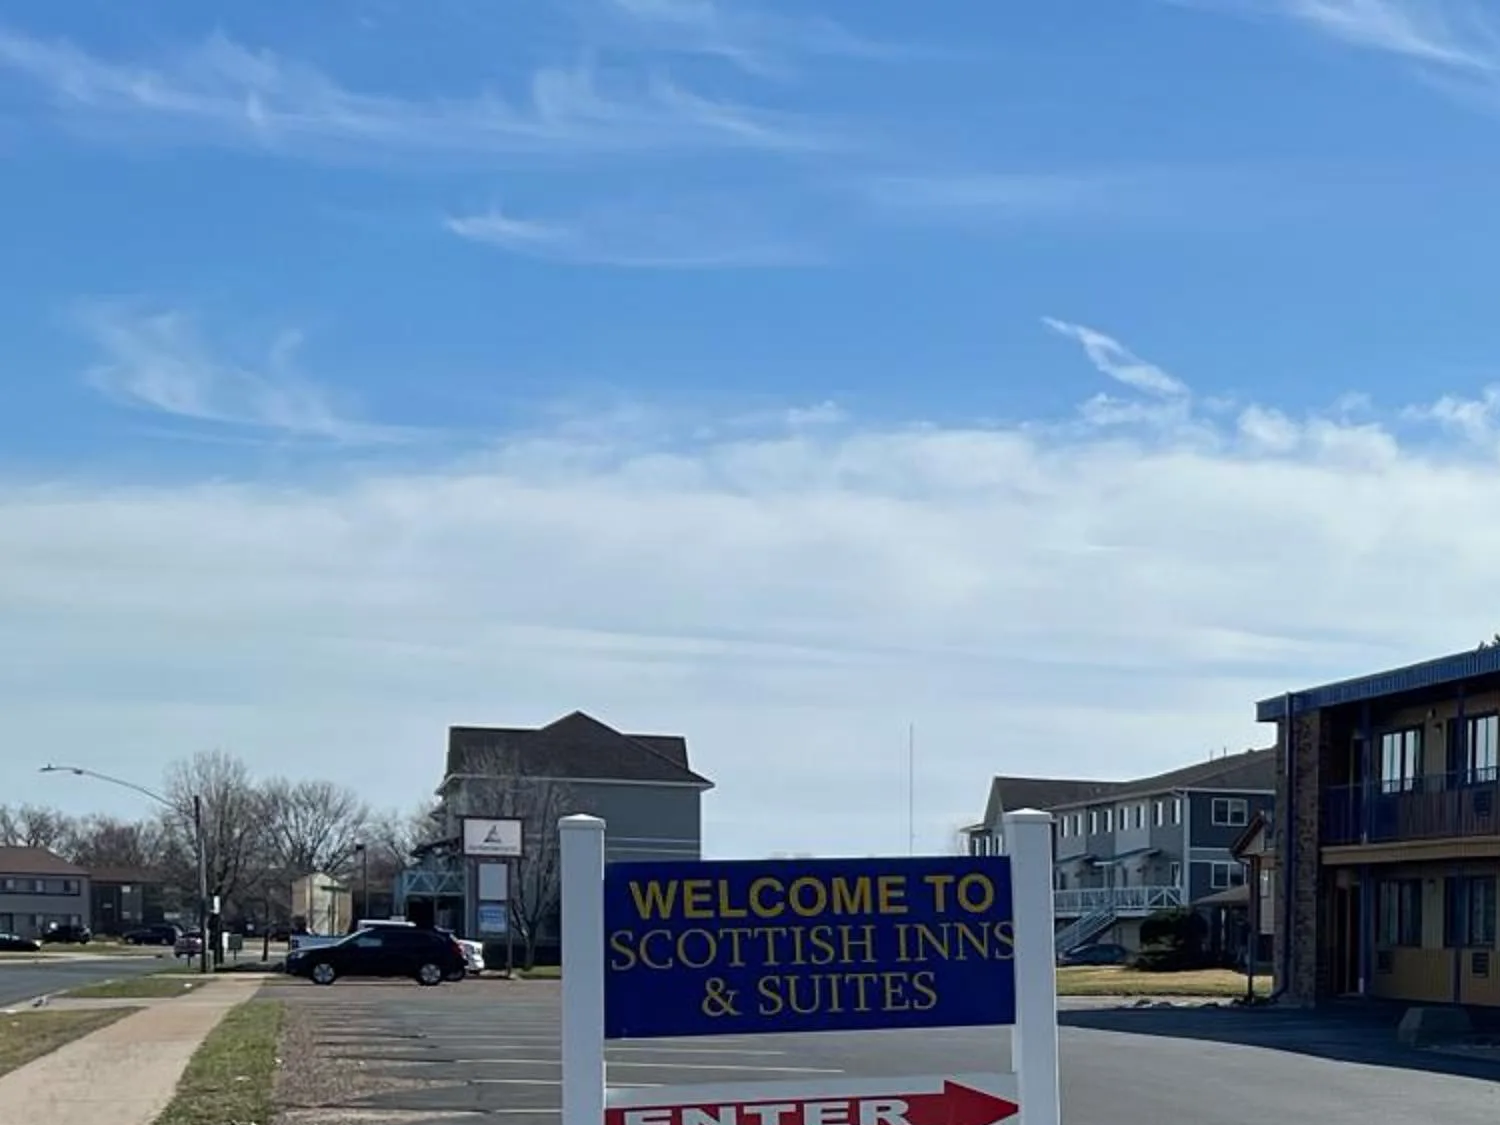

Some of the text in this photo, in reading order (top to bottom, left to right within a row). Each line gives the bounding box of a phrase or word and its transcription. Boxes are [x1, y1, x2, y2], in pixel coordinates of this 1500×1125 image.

[629, 873, 995, 920] WELCOME TO
[611, 921, 1015, 971] SCOTTISH INNS
[702, 971, 938, 1016] & SUITES
